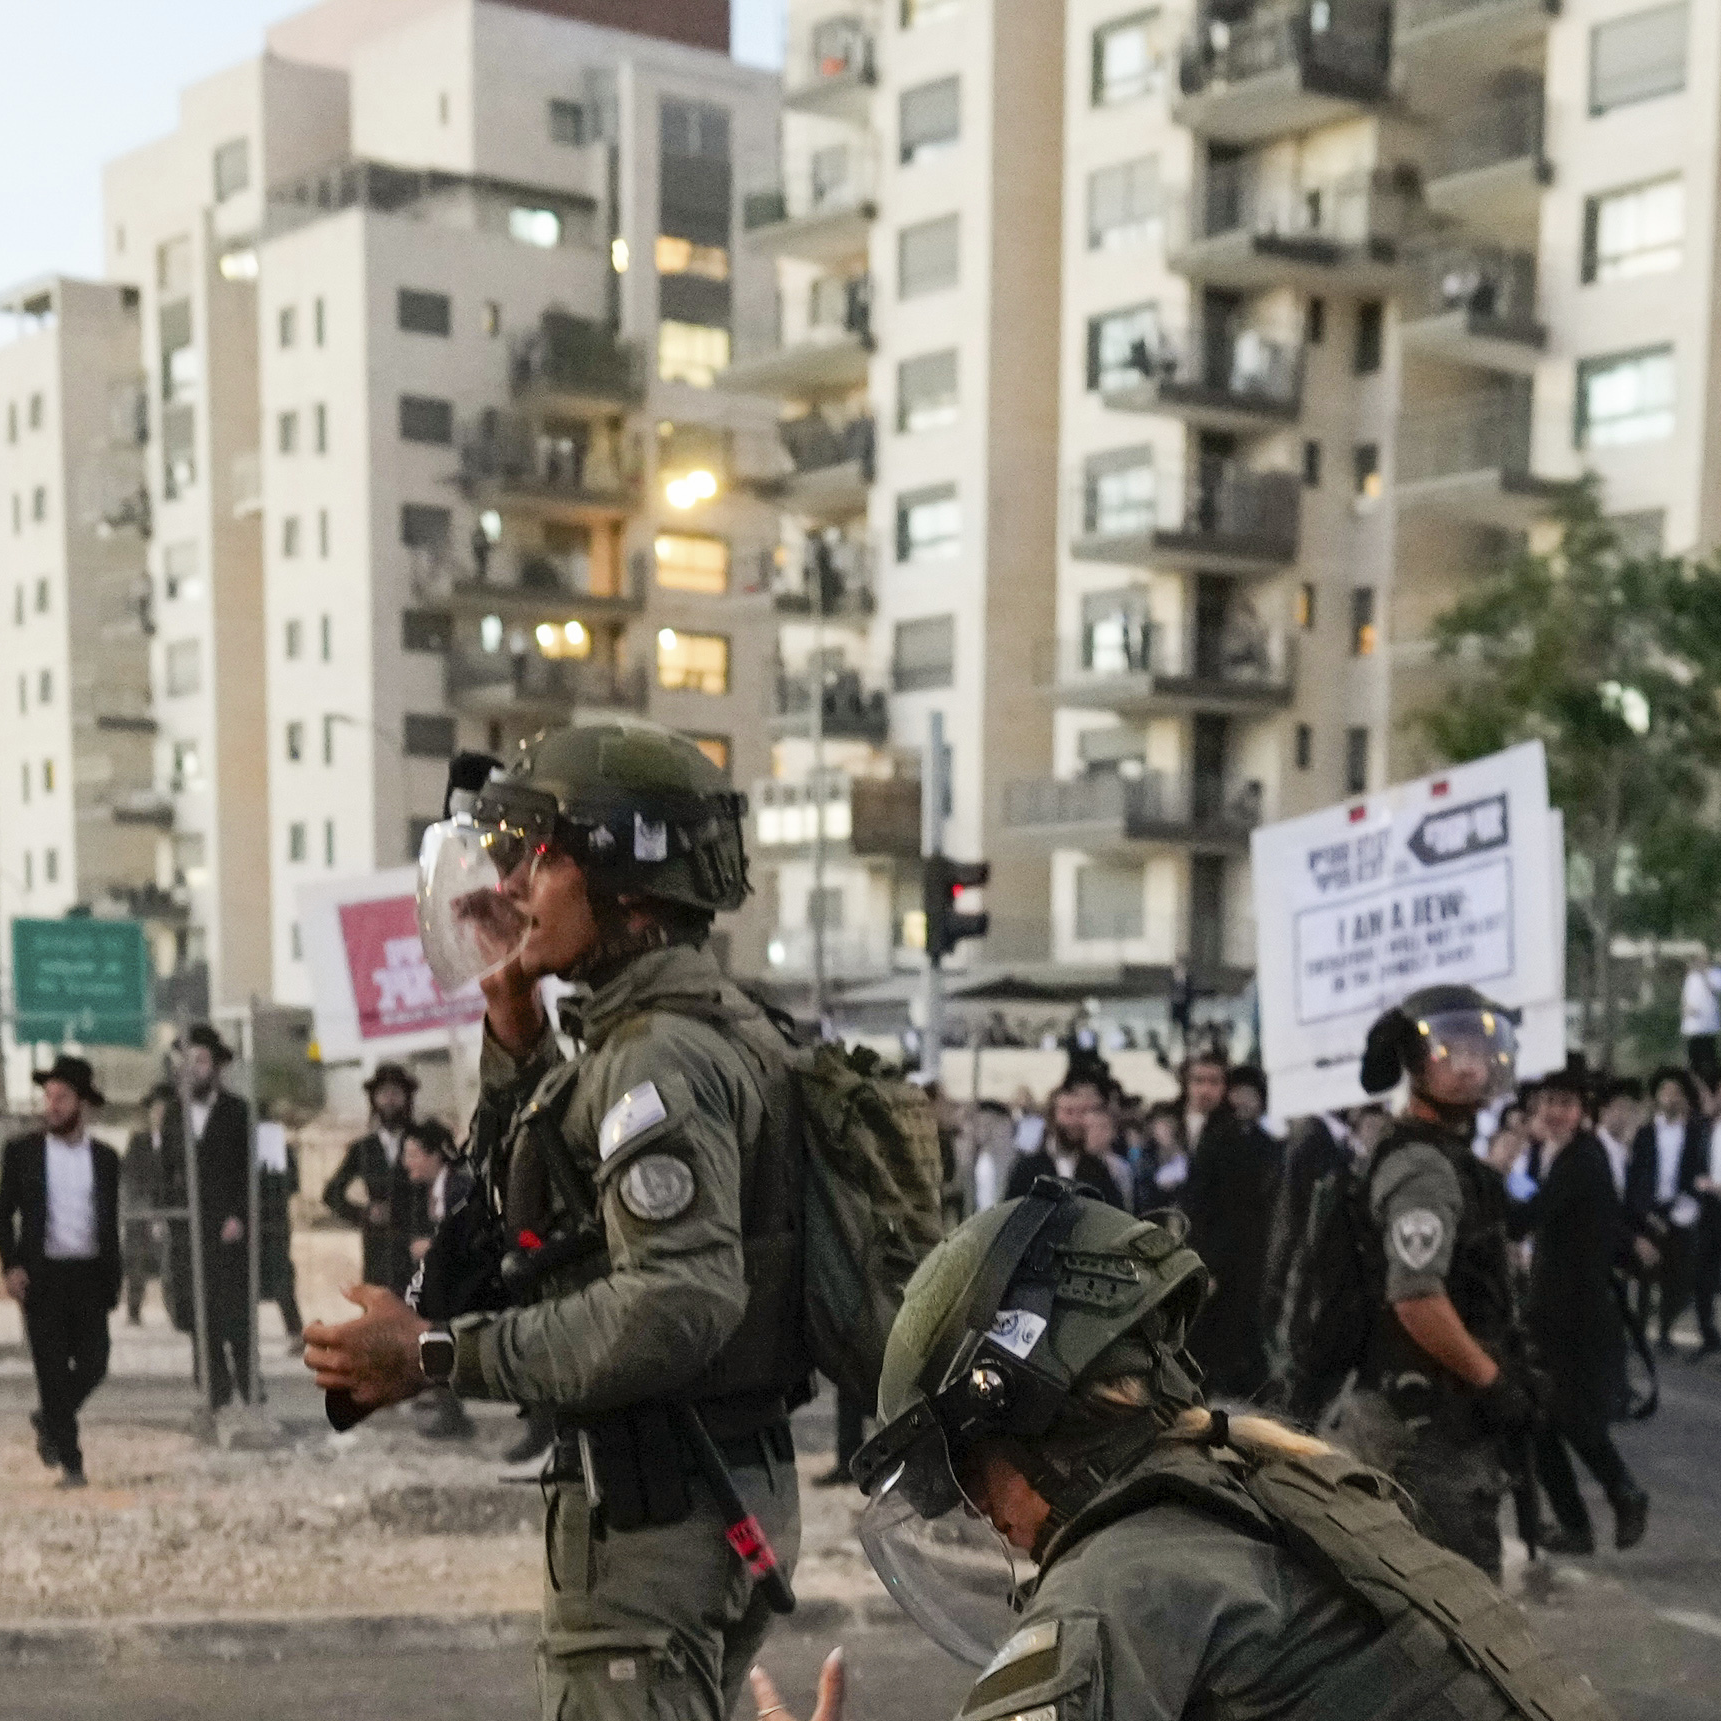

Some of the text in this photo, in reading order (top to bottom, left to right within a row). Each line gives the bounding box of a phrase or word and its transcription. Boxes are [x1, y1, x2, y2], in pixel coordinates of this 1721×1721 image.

[1337, 918, 1346, 945] I
[1353, 908, 1383, 942] AM
[1391, 900, 1403, 930] A
